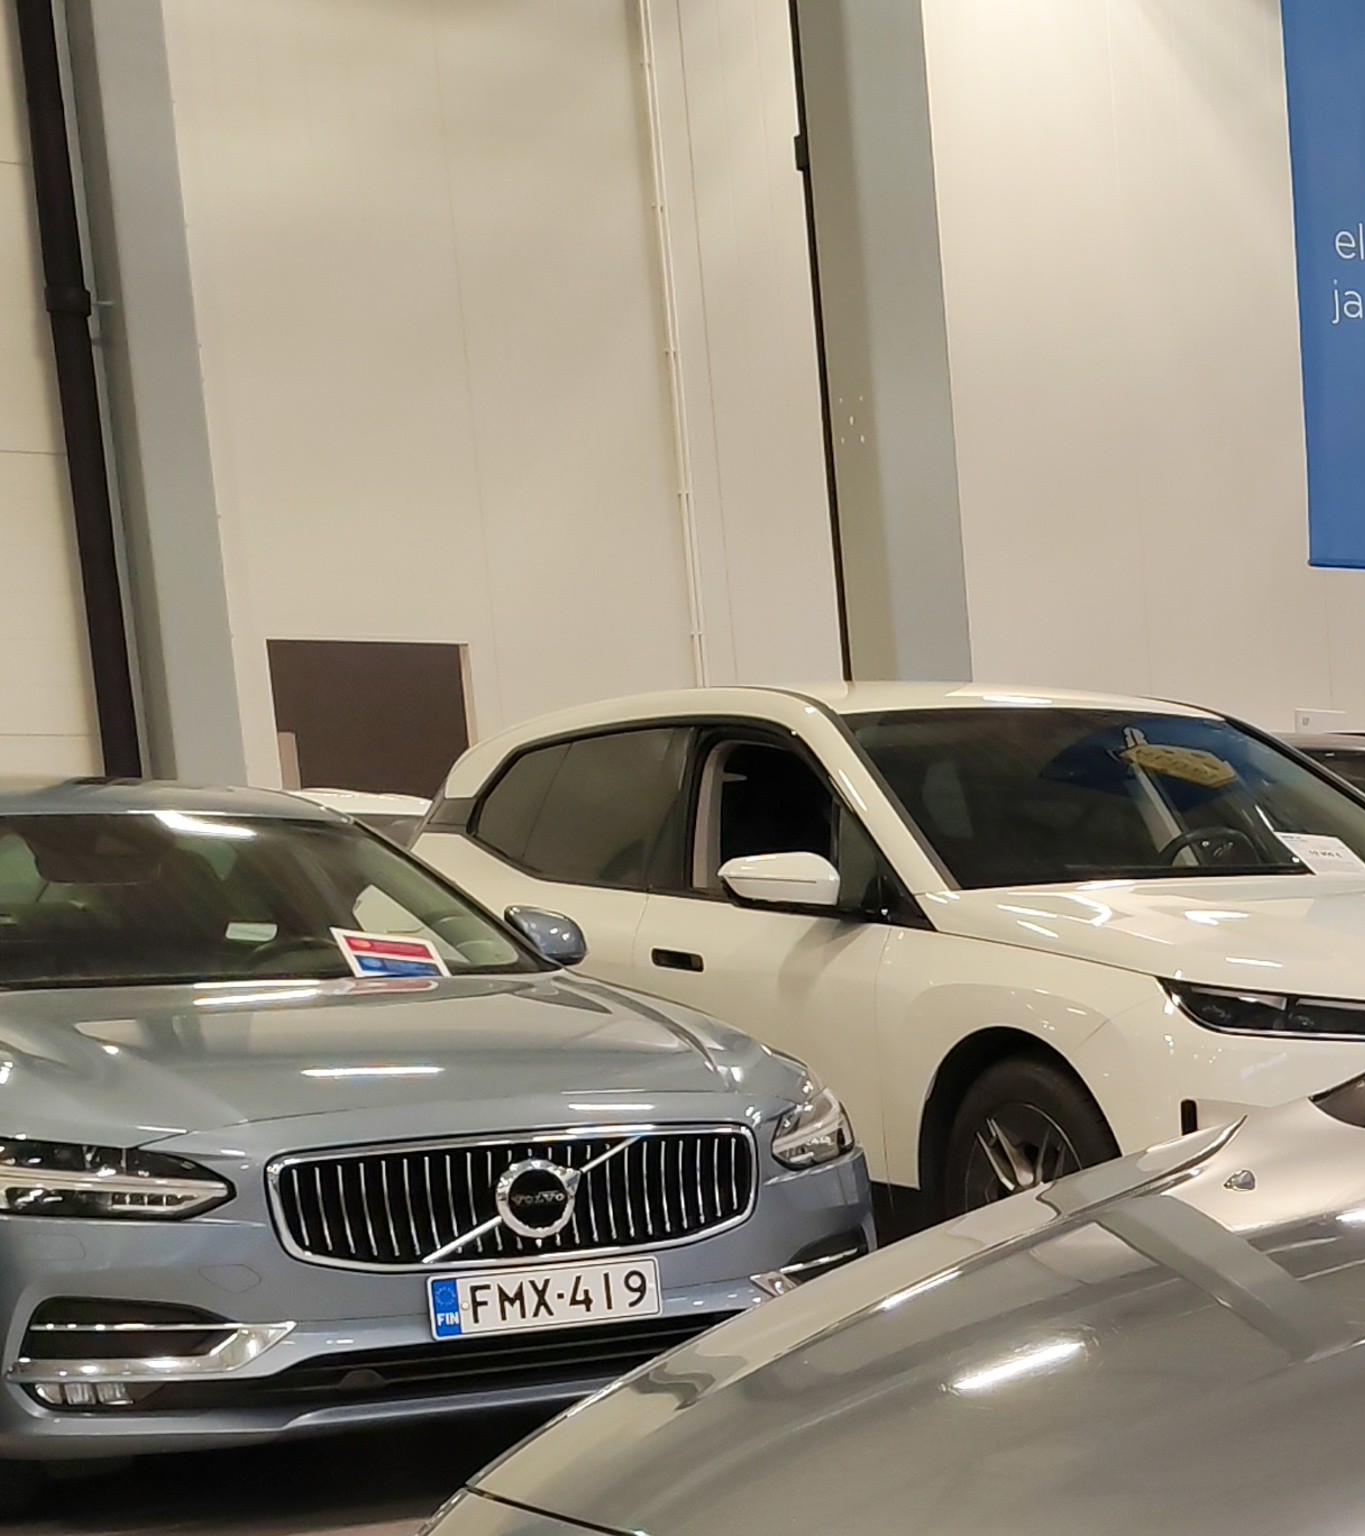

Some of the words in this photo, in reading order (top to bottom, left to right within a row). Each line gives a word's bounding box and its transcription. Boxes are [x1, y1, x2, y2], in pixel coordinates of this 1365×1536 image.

[1331, 279, 1364, 325] ja
[436, 1311, 459, 1327] FIN
[469, 1269, 647, 1325] FMX-419
